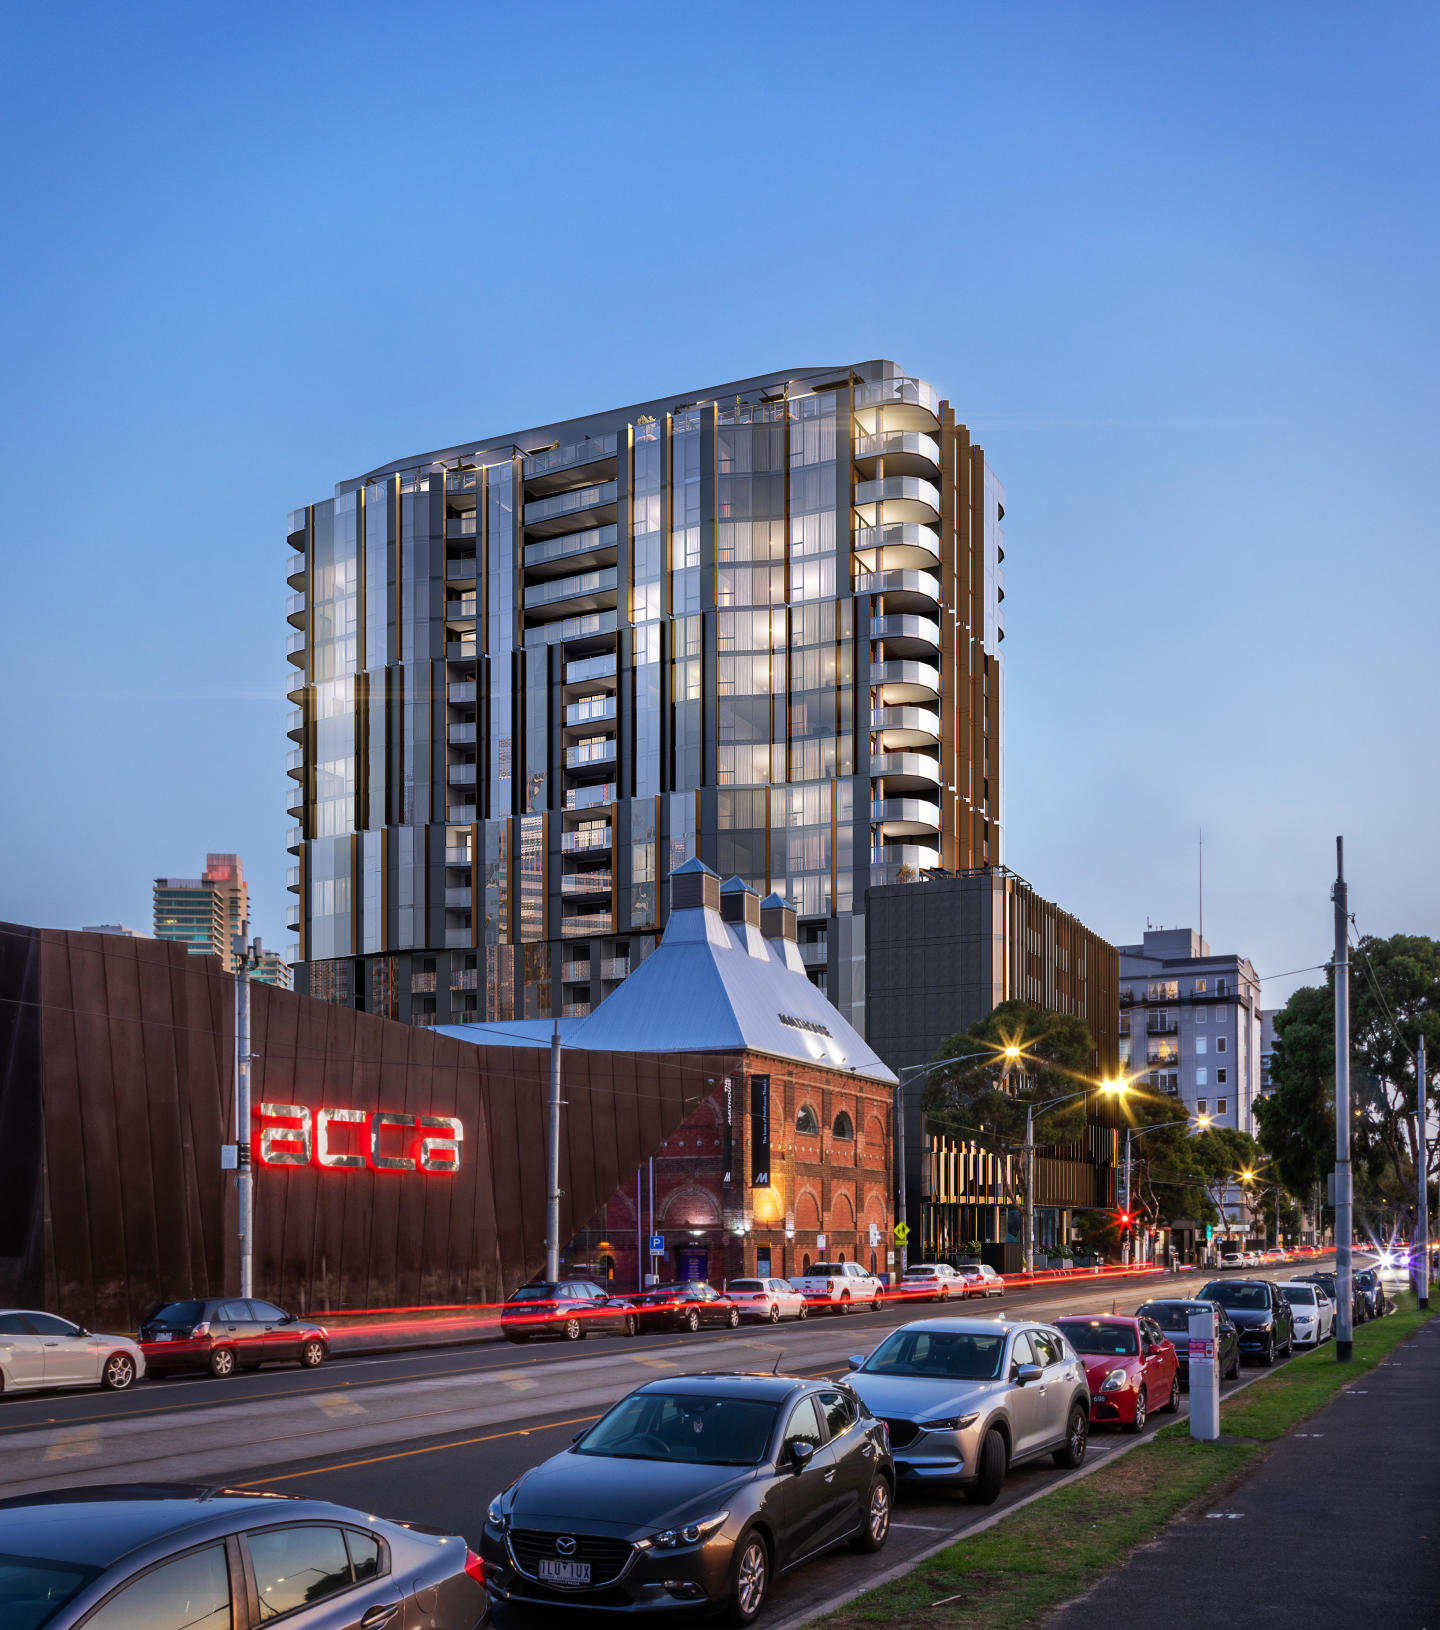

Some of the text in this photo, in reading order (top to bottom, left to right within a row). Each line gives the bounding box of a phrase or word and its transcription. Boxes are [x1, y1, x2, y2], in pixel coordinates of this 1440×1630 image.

[260, 1102, 464, 1172] acca
[755, 1172, 768, 1183] M
[653, 1238, 661, 1248] P
